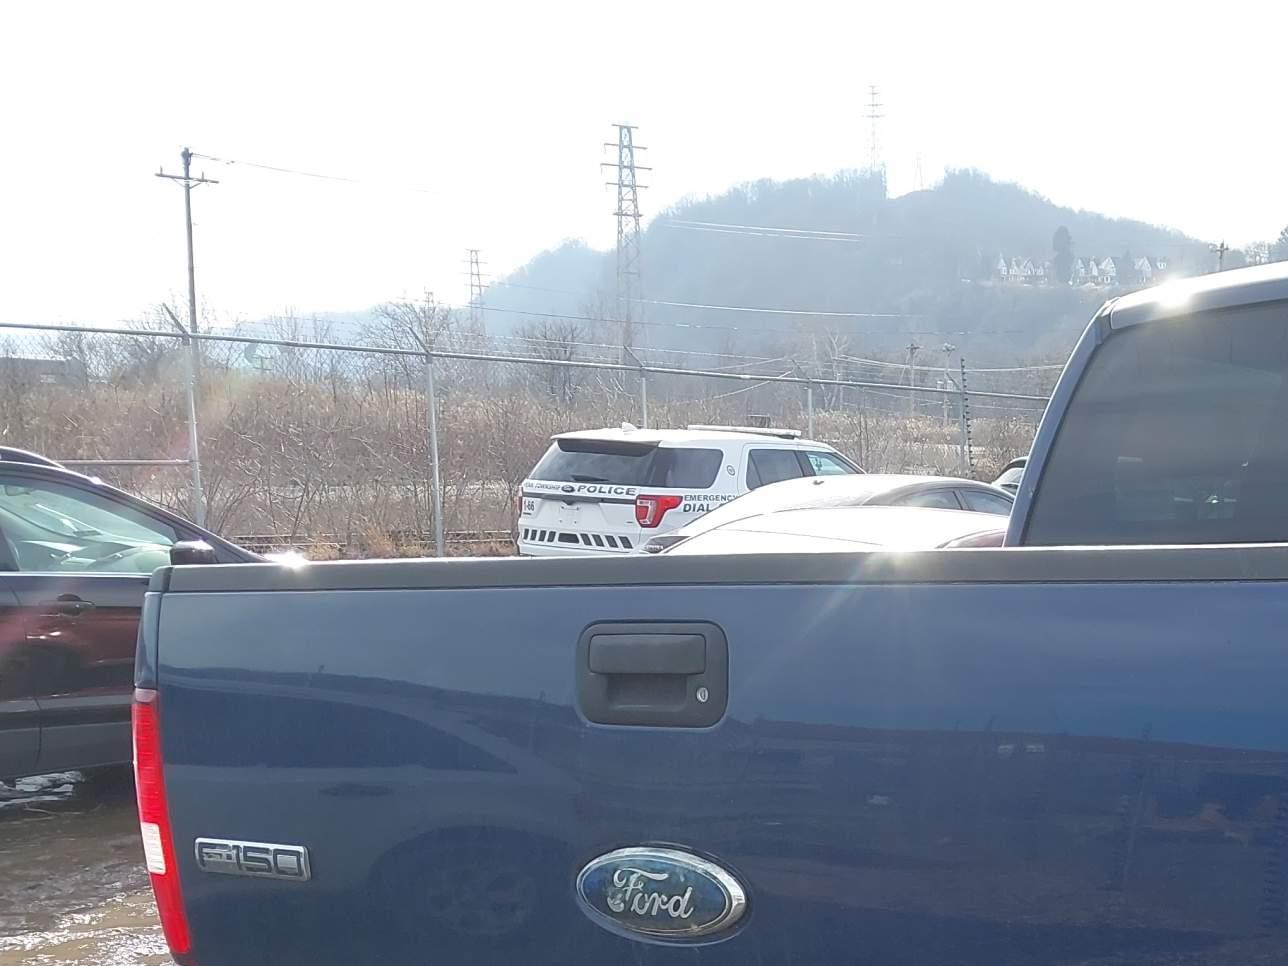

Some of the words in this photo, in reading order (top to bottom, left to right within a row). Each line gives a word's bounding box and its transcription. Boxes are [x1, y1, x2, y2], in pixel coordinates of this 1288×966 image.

[577, 485, 637, 496] POLICE
[683, 503, 712, 513] DIAL
[607, 867, 694, 919] Ford
